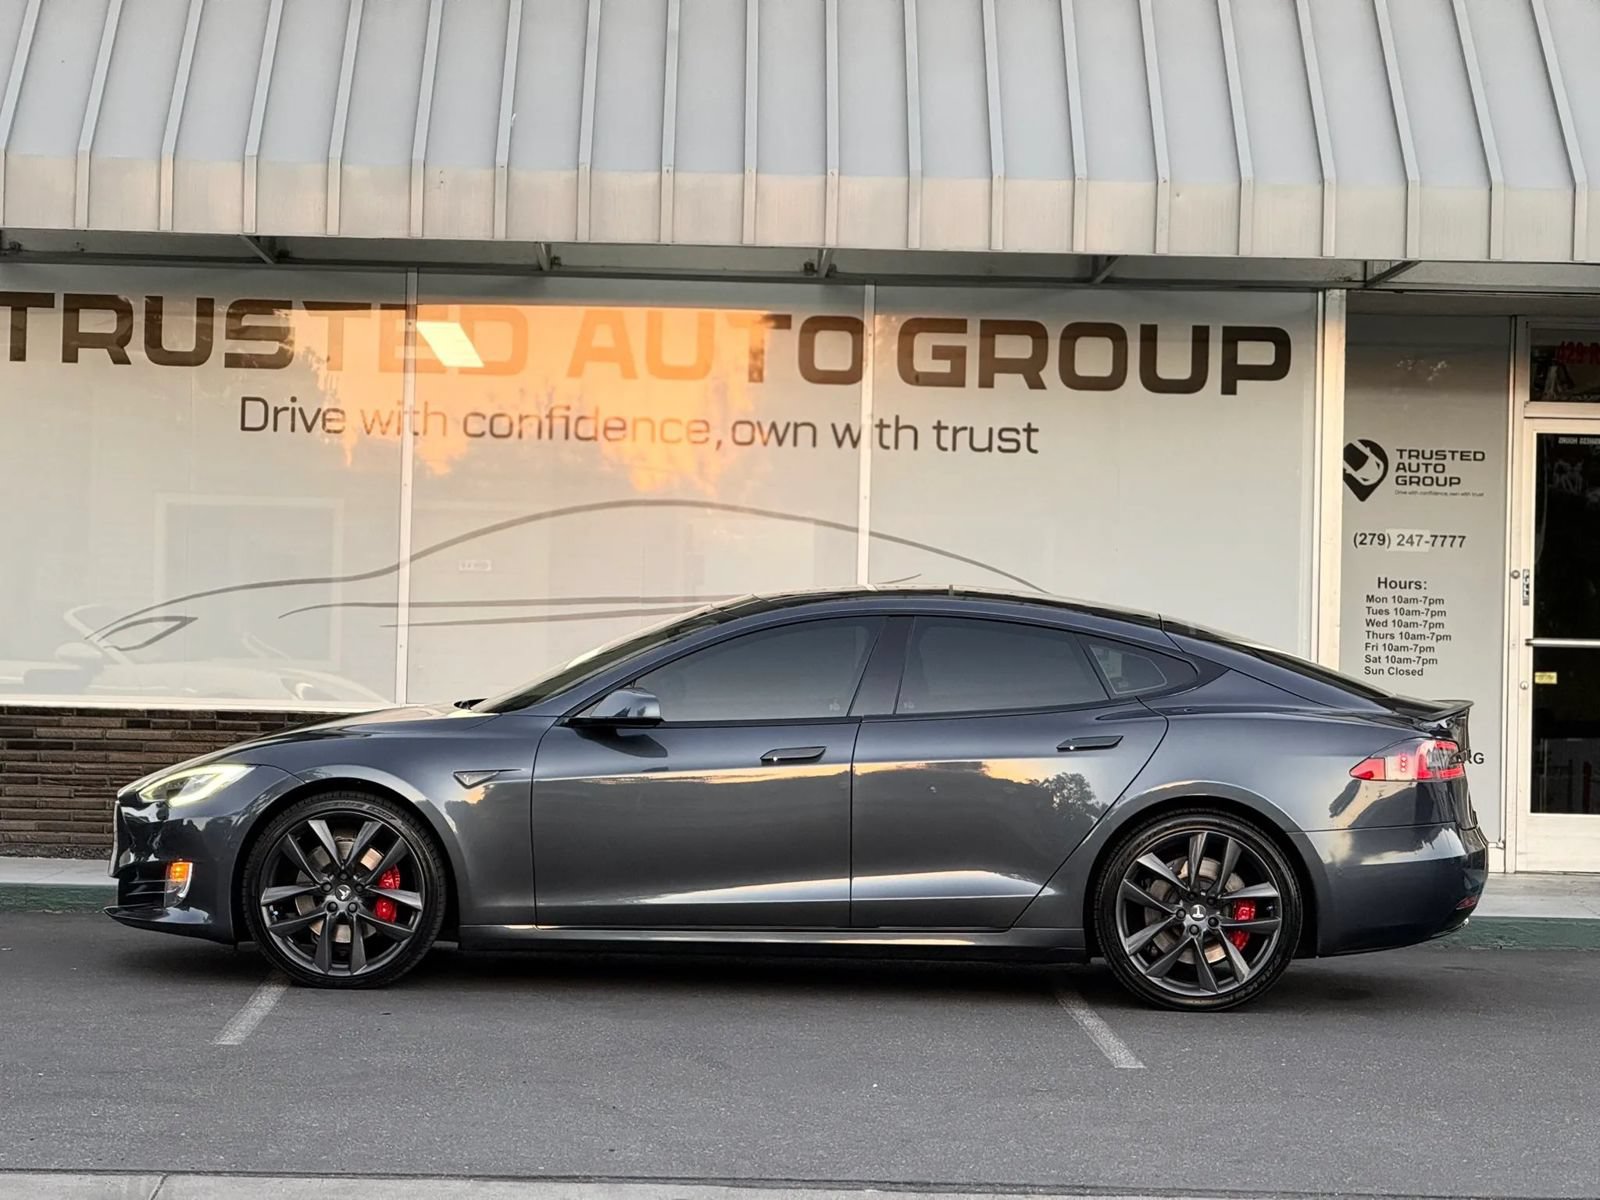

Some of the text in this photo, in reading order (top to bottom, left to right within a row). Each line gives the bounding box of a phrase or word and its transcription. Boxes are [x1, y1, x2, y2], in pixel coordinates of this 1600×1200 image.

[0, 291, 1292, 396] TRUSTED AUTO GROUP
[240, 396, 346, 434] Drive
[463, 405, 723, 451] confidence,
[731, 420, 817, 448] own
[831, 414, 919, 451] wth
[932, 419, 1040, 455] trust
[1395, 448, 1486, 462] TRUSTED
[1395, 462, 1446, 474] AUTO
[1395, 475, 1462, 488] GROUP
[1353, 532, 1467, 549] (279) 247-7777
[1377, 577, 1428, 590] Hours:
[1365, 594, 1445, 607] Mon 10am-7pm
[1365, 606, 1447, 618] Tues 10am-7pm
[1365, 618, 1445, 631] Wed 10am-7pm
[1365, 630, 1452, 643] Thurs 10am-7pm
[1364, 642, 1435, 654] Fri 10am-7pm
[1364, 654, 1438, 666] Sat 10am-7pm
[1364, 666, 1424, 676] Sun Closed
